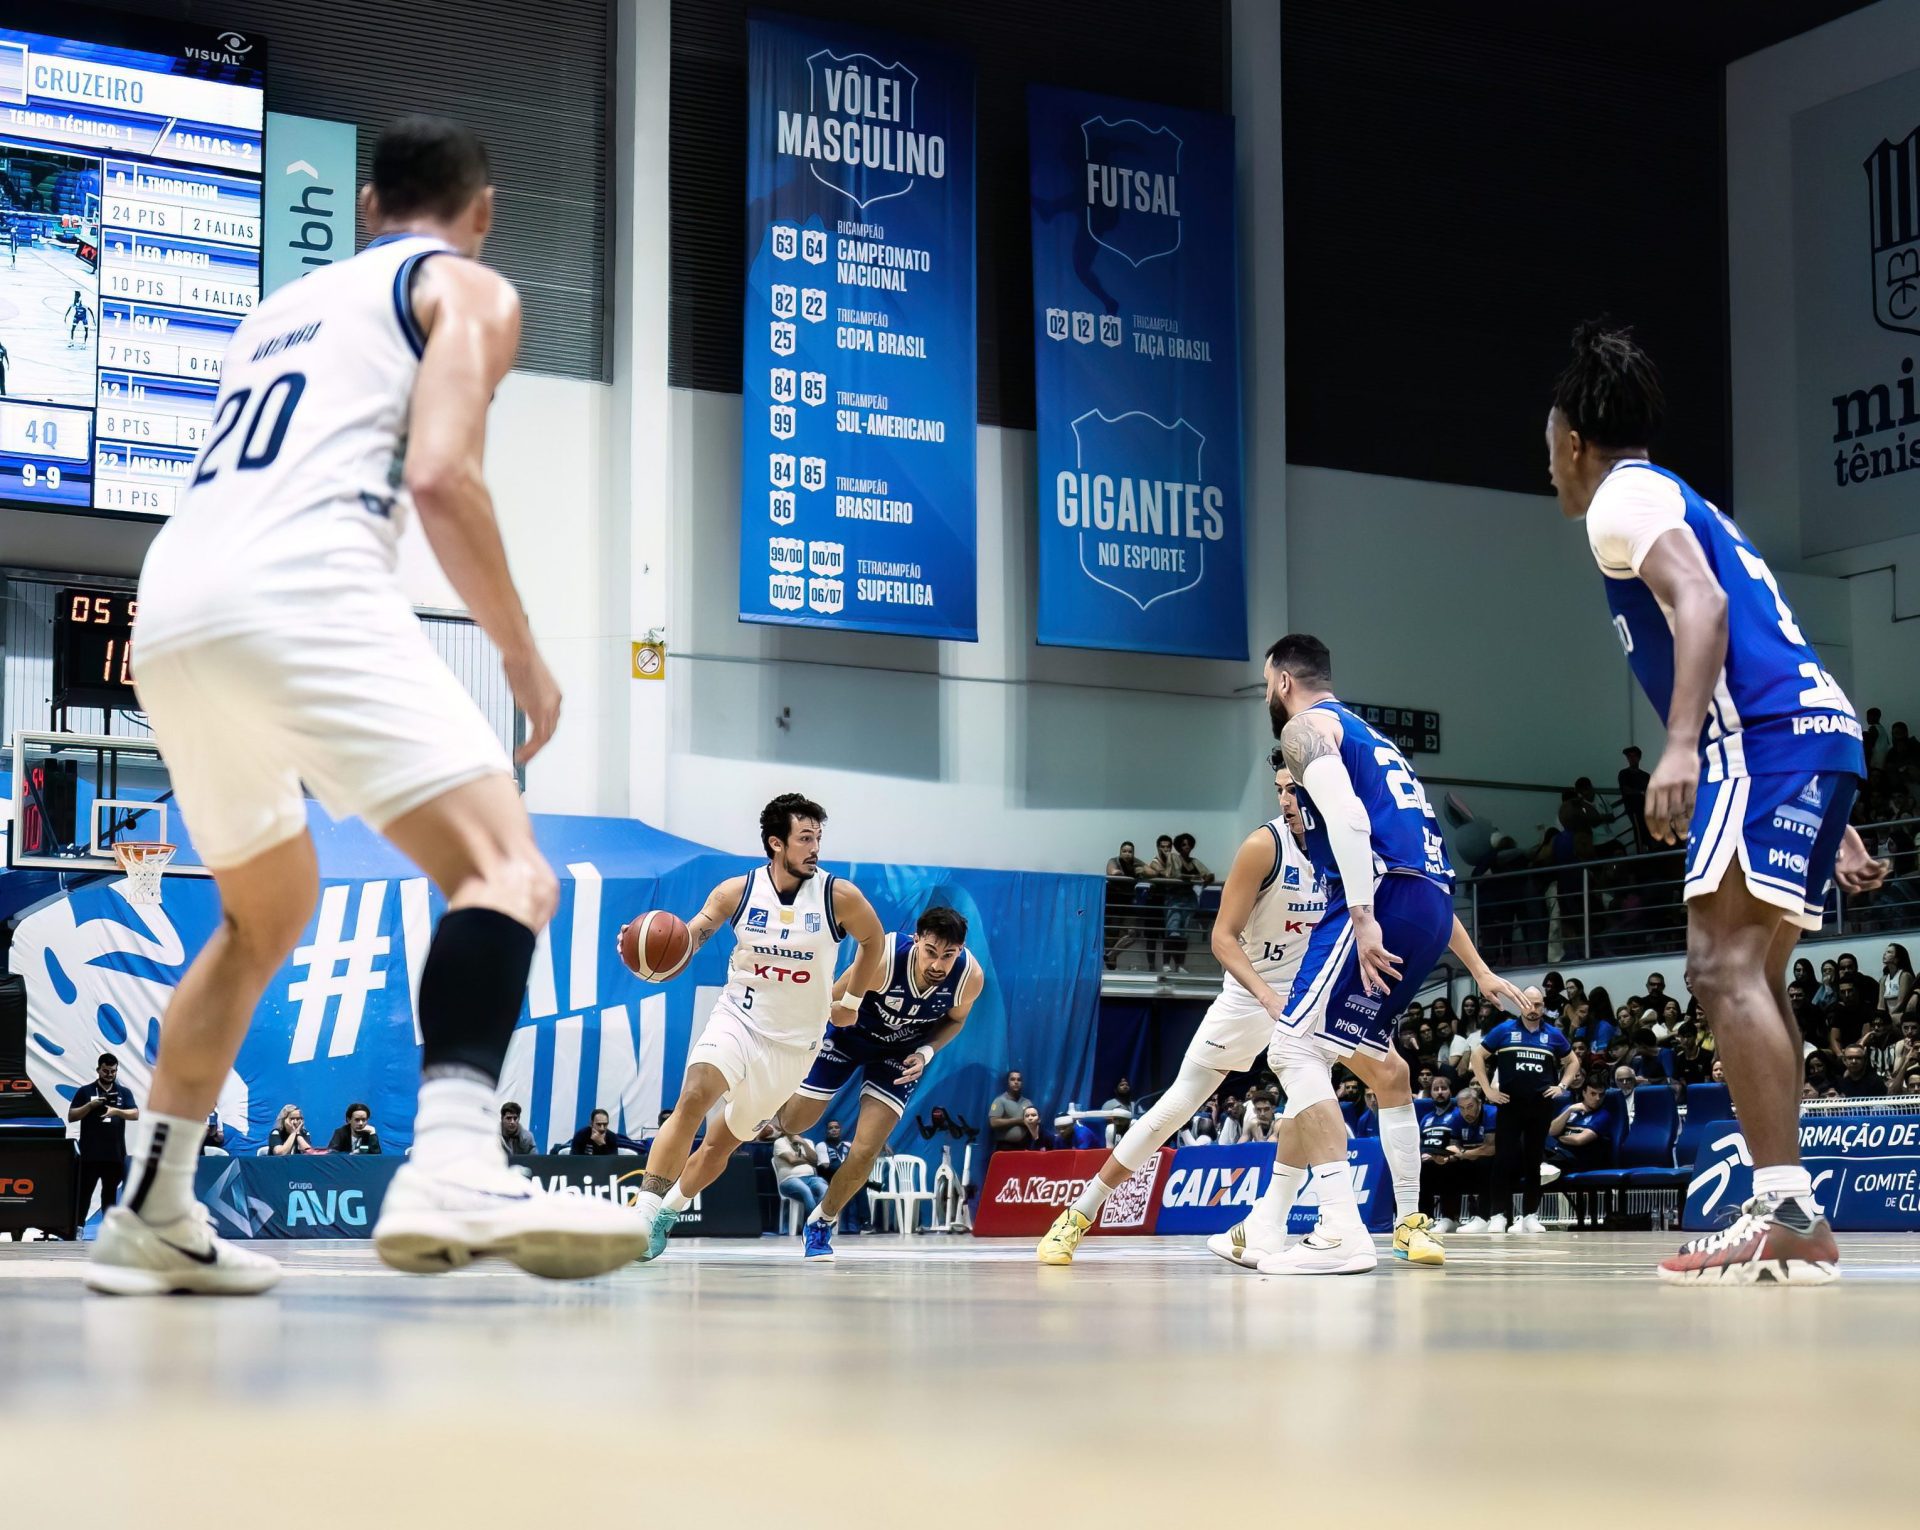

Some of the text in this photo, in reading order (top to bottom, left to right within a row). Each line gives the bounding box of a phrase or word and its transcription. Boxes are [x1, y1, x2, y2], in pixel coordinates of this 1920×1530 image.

[35, 65, 143, 104] CRUZEIRO
[824, 65, 900, 123] VÔLEI
[9, 109, 133, 141] TEMPO TÉCNICO: 1
[175, 132, 253, 160] FALTAS: 2
[777, 110, 945, 179] MASCULINO
[1087, 162, 1181, 217] FUTSAL
[112, 205, 165, 227] 24 PTS
[193, 218, 254, 239] 2 FALTAS
[837, 220, 884, 240] BICAMPEÃO
[135, 245, 161, 264] LEO
[776, 233, 823, 259] 63 64
[837, 238, 931, 272] CAMPEONATO
[112, 276, 164, 296] 10 PTS
[837, 261, 908, 292] NACIONAL
[192, 287, 252, 308] 4 FALTAS
[775, 292, 823, 317] 82 22
[113, 312, 123, 328] 7
[134, 315, 169, 334] CLAY
[837, 307, 889, 328] TRICAMPEÃO
[1050, 315, 1119, 342] 02 12 20
[774, 329, 792, 350] 25
[836, 326, 927, 359] COPA BRASIL
[1133, 332, 1213, 362] TAÇA BRASIL
[109, 346, 151, 365] 7 PTS
[190, 357, 197, 370] 0
[101, 381, 120, 399] 12
[774, 376, 823, 400] 84 85
[836, 391, 888, 411] TRICAMPEÃO
[107, 417, 150, 436] 8 PTS
[188, 427, 196, 440] 3
[189, 371, 307, 488] 20
[774, 412, 792, 434] 99
[836, 409, 945, 443] SUL-AMERICANO
[25, 420, 58, 450] 4Q
[98, 452, 119, 469] 22
[22, 463, 61, 490] 9-9
[774, 461, 822, 485] 84 85
[836, 476, 888, 496] TRICAMPEÃO
[107, 488, 159, 507] 11 PTS
[773, 498, 791, 519] 86
[1056, 470, 1224, 541] GIGANTES
[835, 495, 913, 524] BRASILEIRO
[770, 546, 841, 567] 99/00 00/01
[1098, 541, 1186, 573] NO ESPORTE
[857, 559, 921, 579] TETRACAMPEÃO
[772, 583, 841, 604] 01/02 06/07
[857, 578, 934, 606] SUPERLIGA
[71, 596, 111, 624] 05
[752, 945, 814, 961] minas
[1263, 941, 1287, 961] 15
[754, 964, 811, 984] KTO
[742, 985, 756, 1010] 5
[1344, 1001, 1378, 1017] ORIZON
[1516, 1051, 1546, 1061] minas
[1515, 1063, 1544, 1073] KTO
[1888, 1124, 1920, 1146] DE
[288, 1181, 313, 1190] Grupo
[1162, 1166, 1260, 1209] CAIXA
[1854, 1169, 1918, 1193] COMITÊ
[287, 1189, 367, 1227] AVG
[1885, 1197, 1897, 1208] DE
